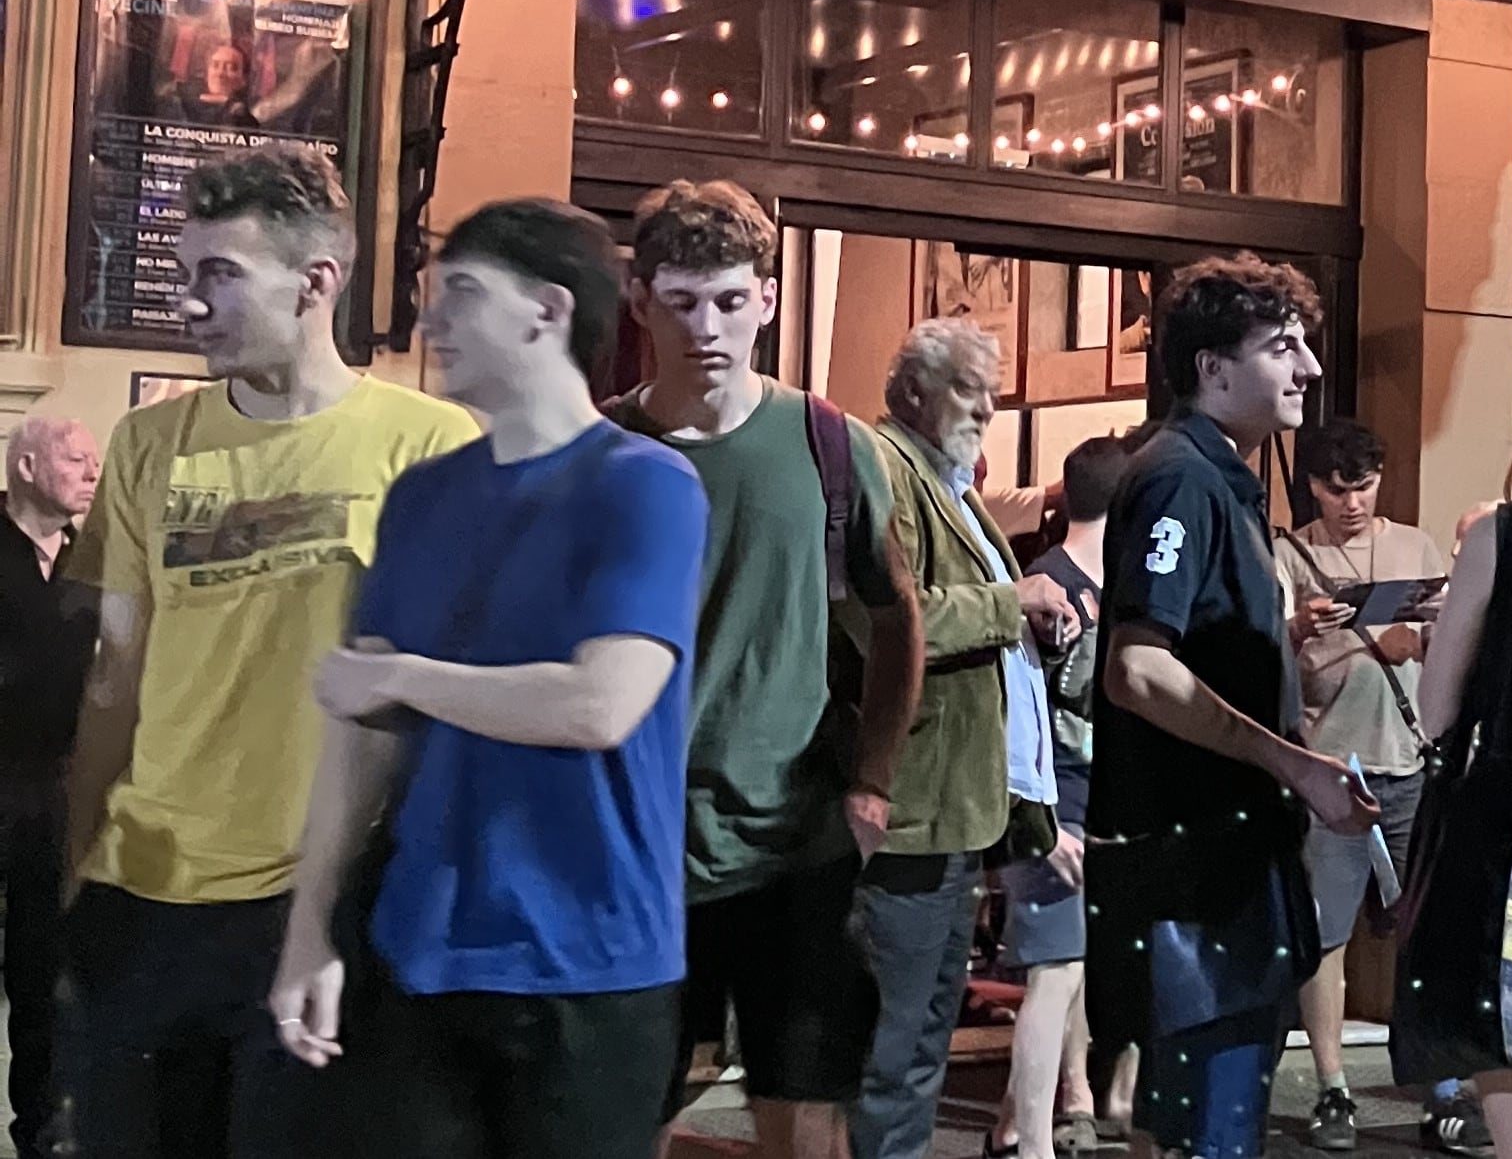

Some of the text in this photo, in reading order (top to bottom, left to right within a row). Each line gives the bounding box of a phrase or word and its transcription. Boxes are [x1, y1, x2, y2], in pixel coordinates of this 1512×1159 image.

[144, 124, 163, 137] LA
[166, 127, 247, 146] CONQUISTA
[1145, 516, 1186, 574] 3
